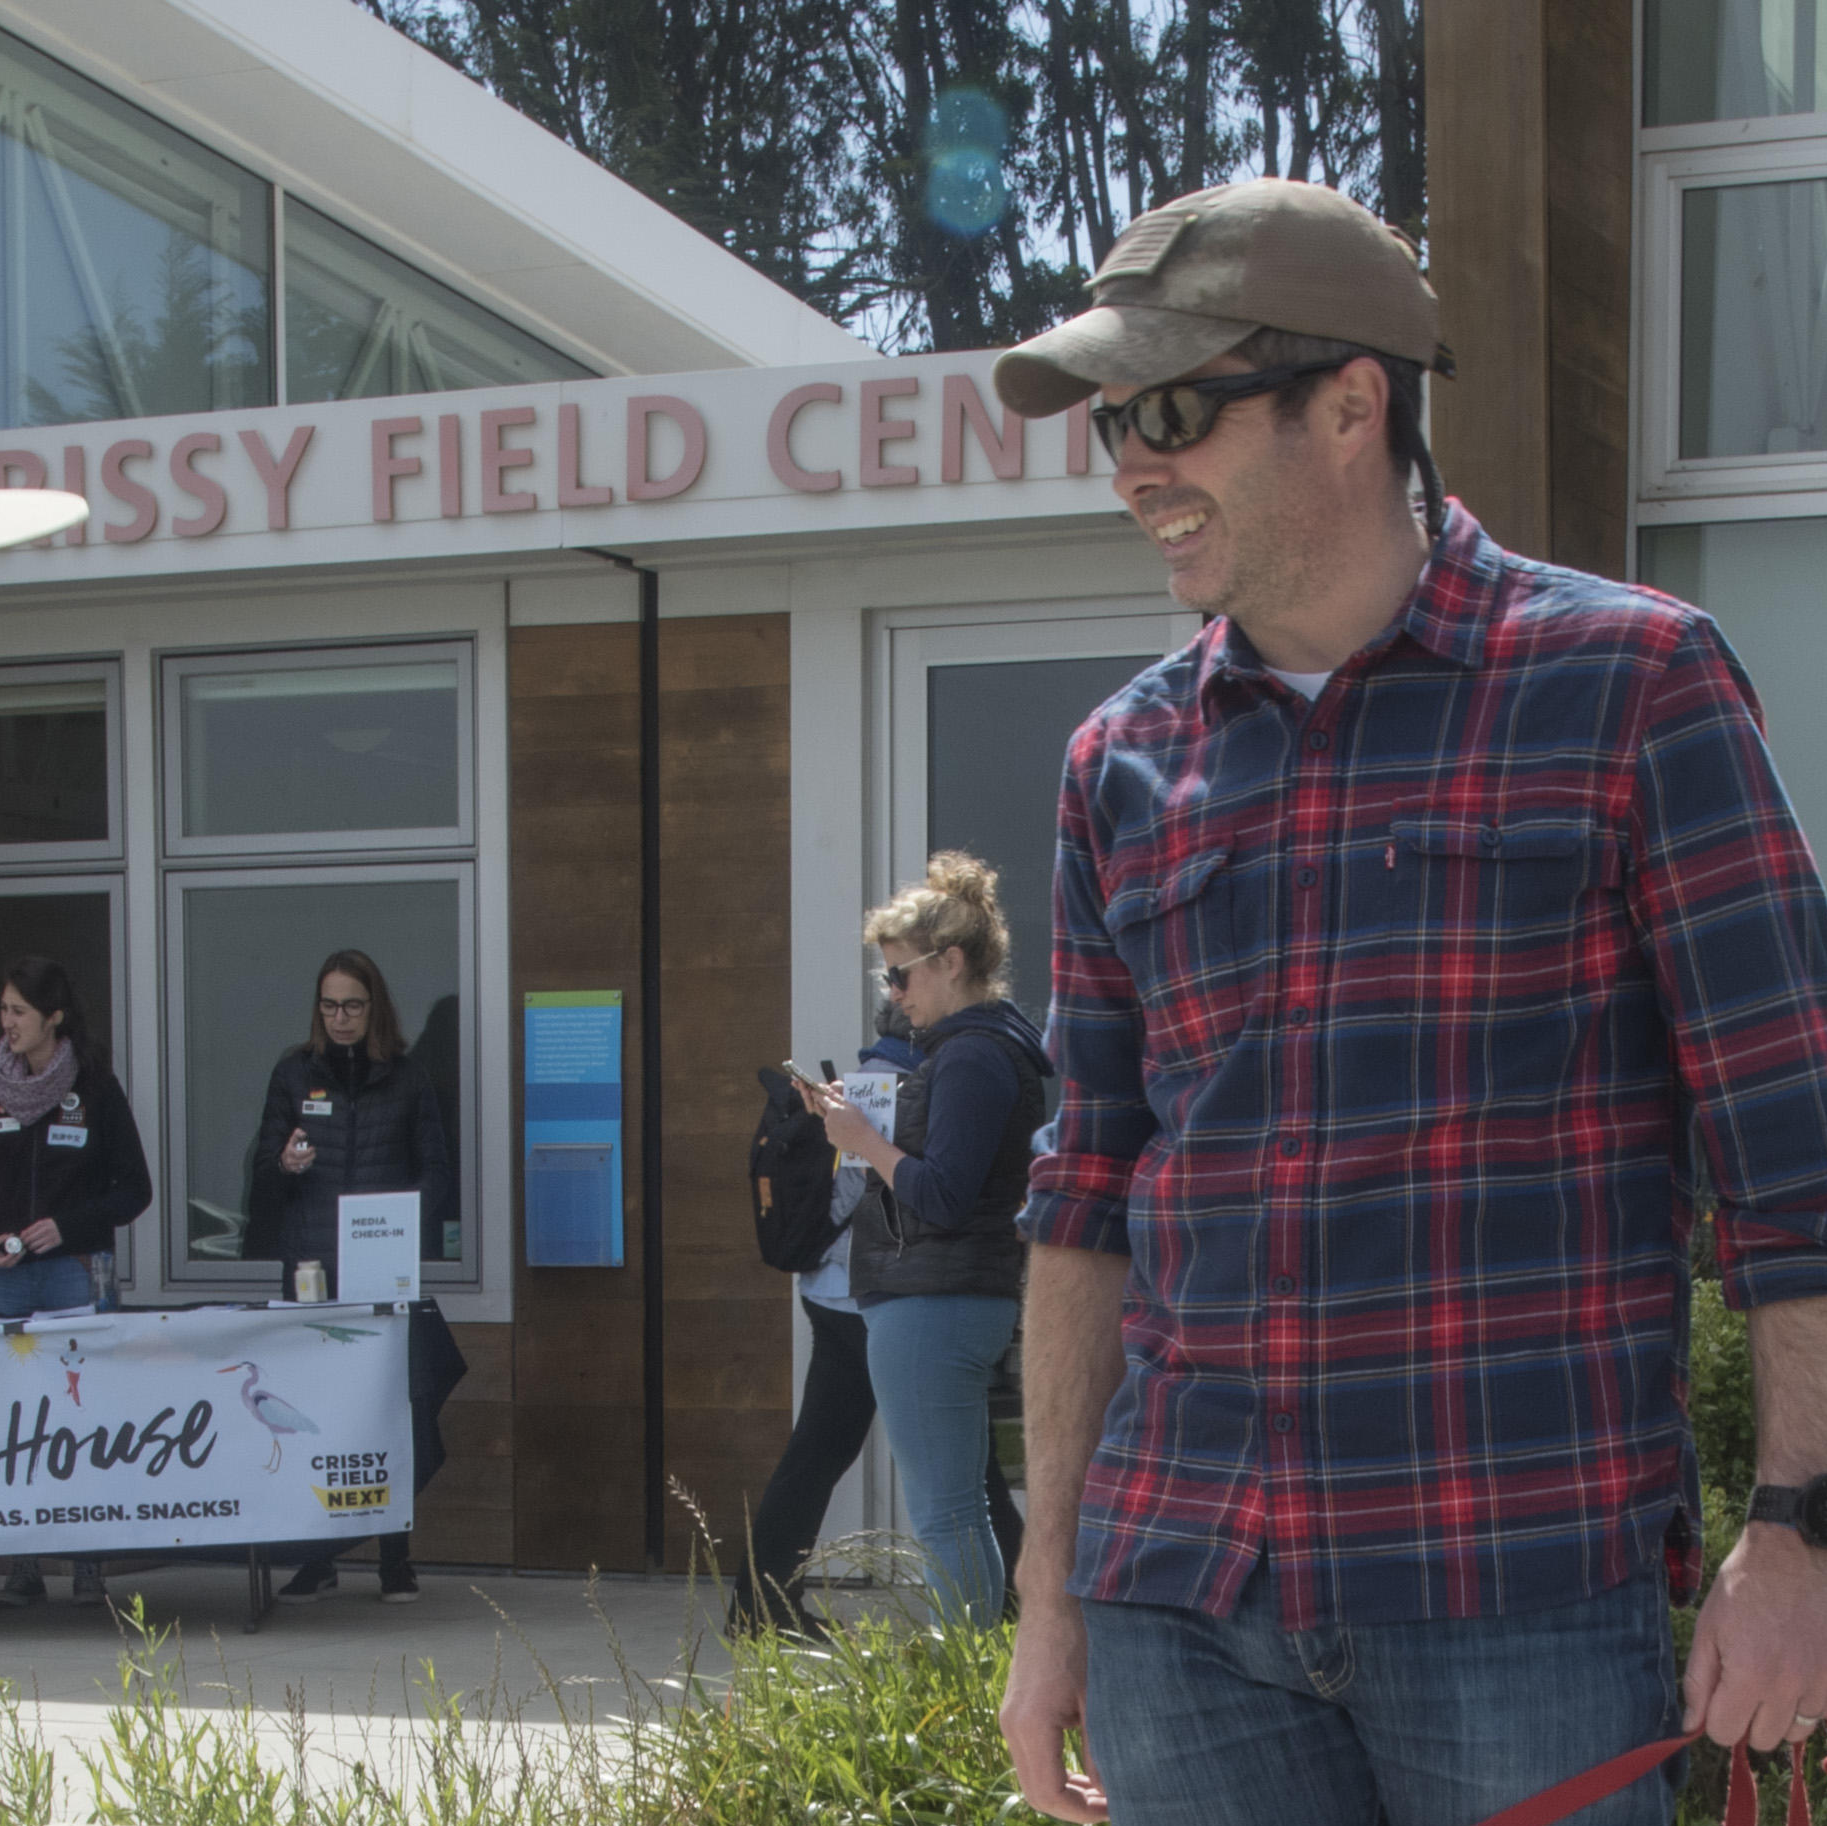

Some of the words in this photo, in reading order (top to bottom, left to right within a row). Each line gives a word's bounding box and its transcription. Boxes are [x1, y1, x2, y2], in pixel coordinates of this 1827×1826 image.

[371, 394, 707, 522] FIELD
[351, 1216, 386, 1227] MEDIA
[352, 1228, 405, 1239] CHECK-IN
[311, 1452, 388, 1470] CRISSY
[327, 1470, 388, 1487] FIELD
[328, 1489, 385, 1507] NEXT
[35, 1504, 131, 1525] DESIGN.
[137, 1499, 241, 1520] SNACKS!
